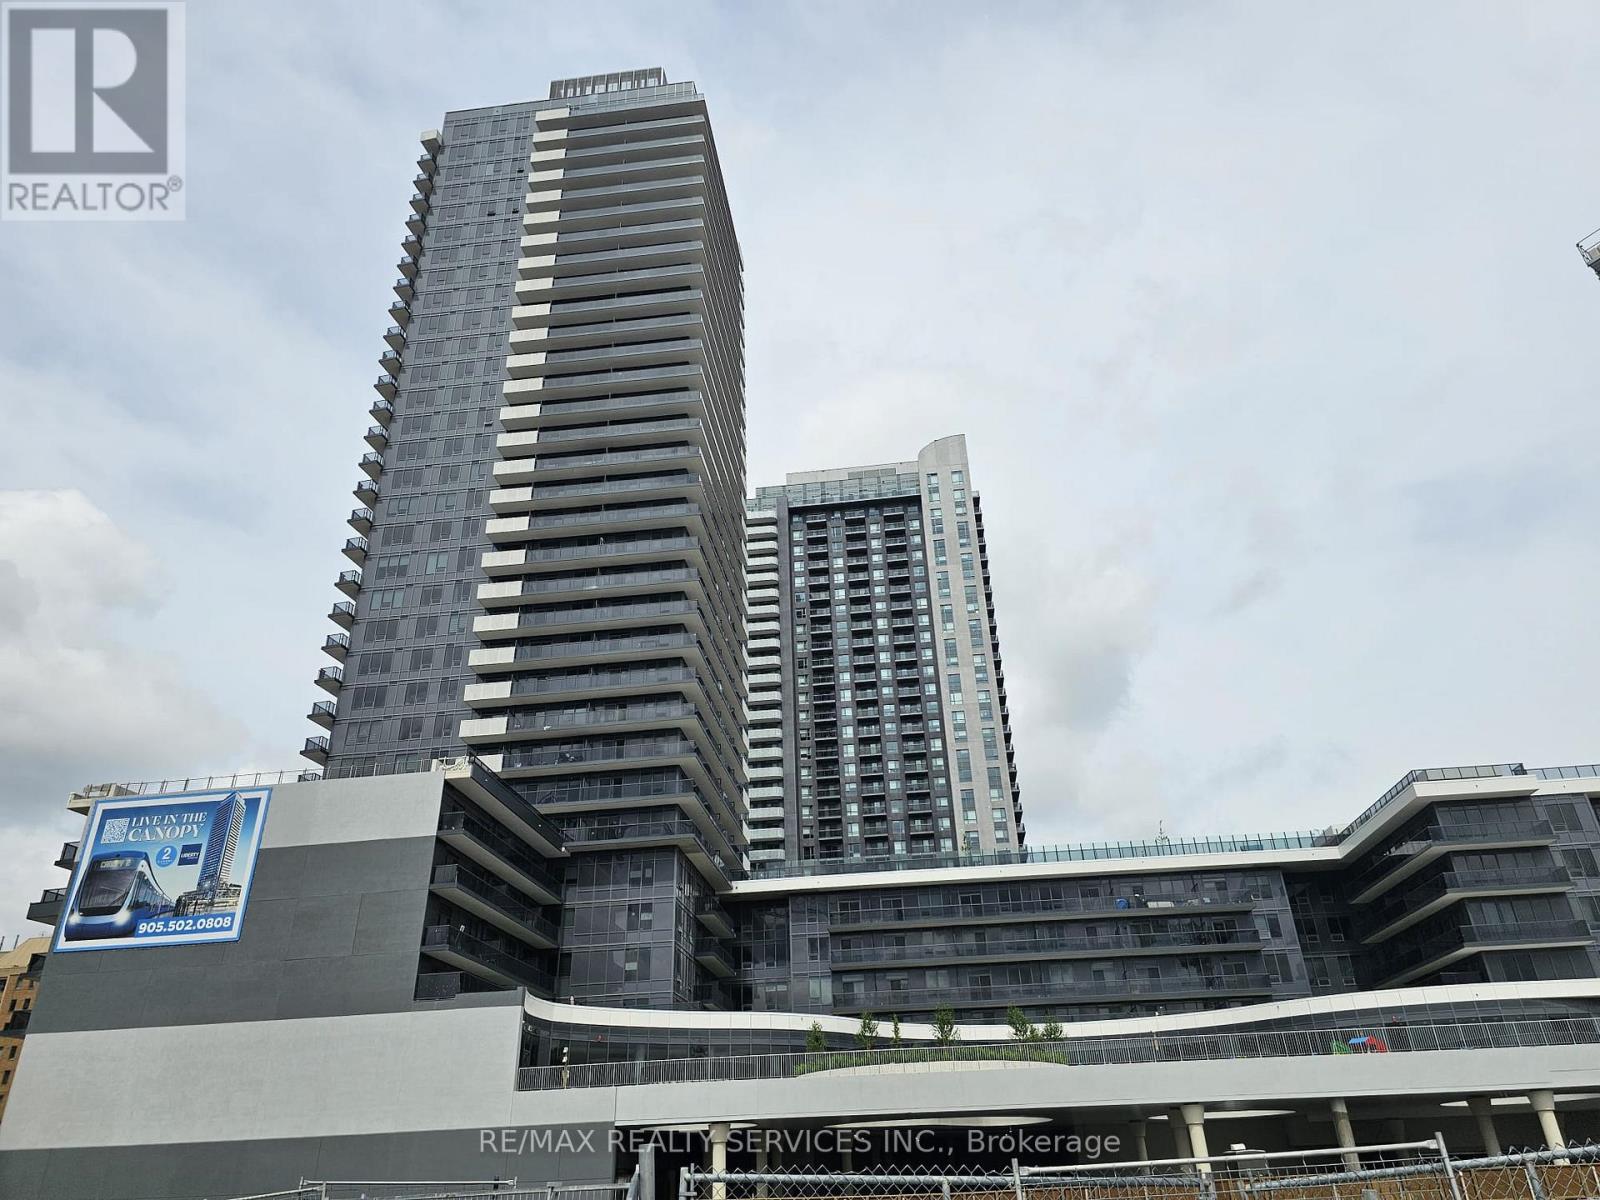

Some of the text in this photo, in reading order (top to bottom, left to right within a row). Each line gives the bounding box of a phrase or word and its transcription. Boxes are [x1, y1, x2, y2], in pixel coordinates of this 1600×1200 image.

[132, 811, 208, 827] LIVE IN THE
[128, 823, 205, 842] CANOPY
[161, 847, 172, 860] 2
[138, 916, 232, 934] 905.502.0808
